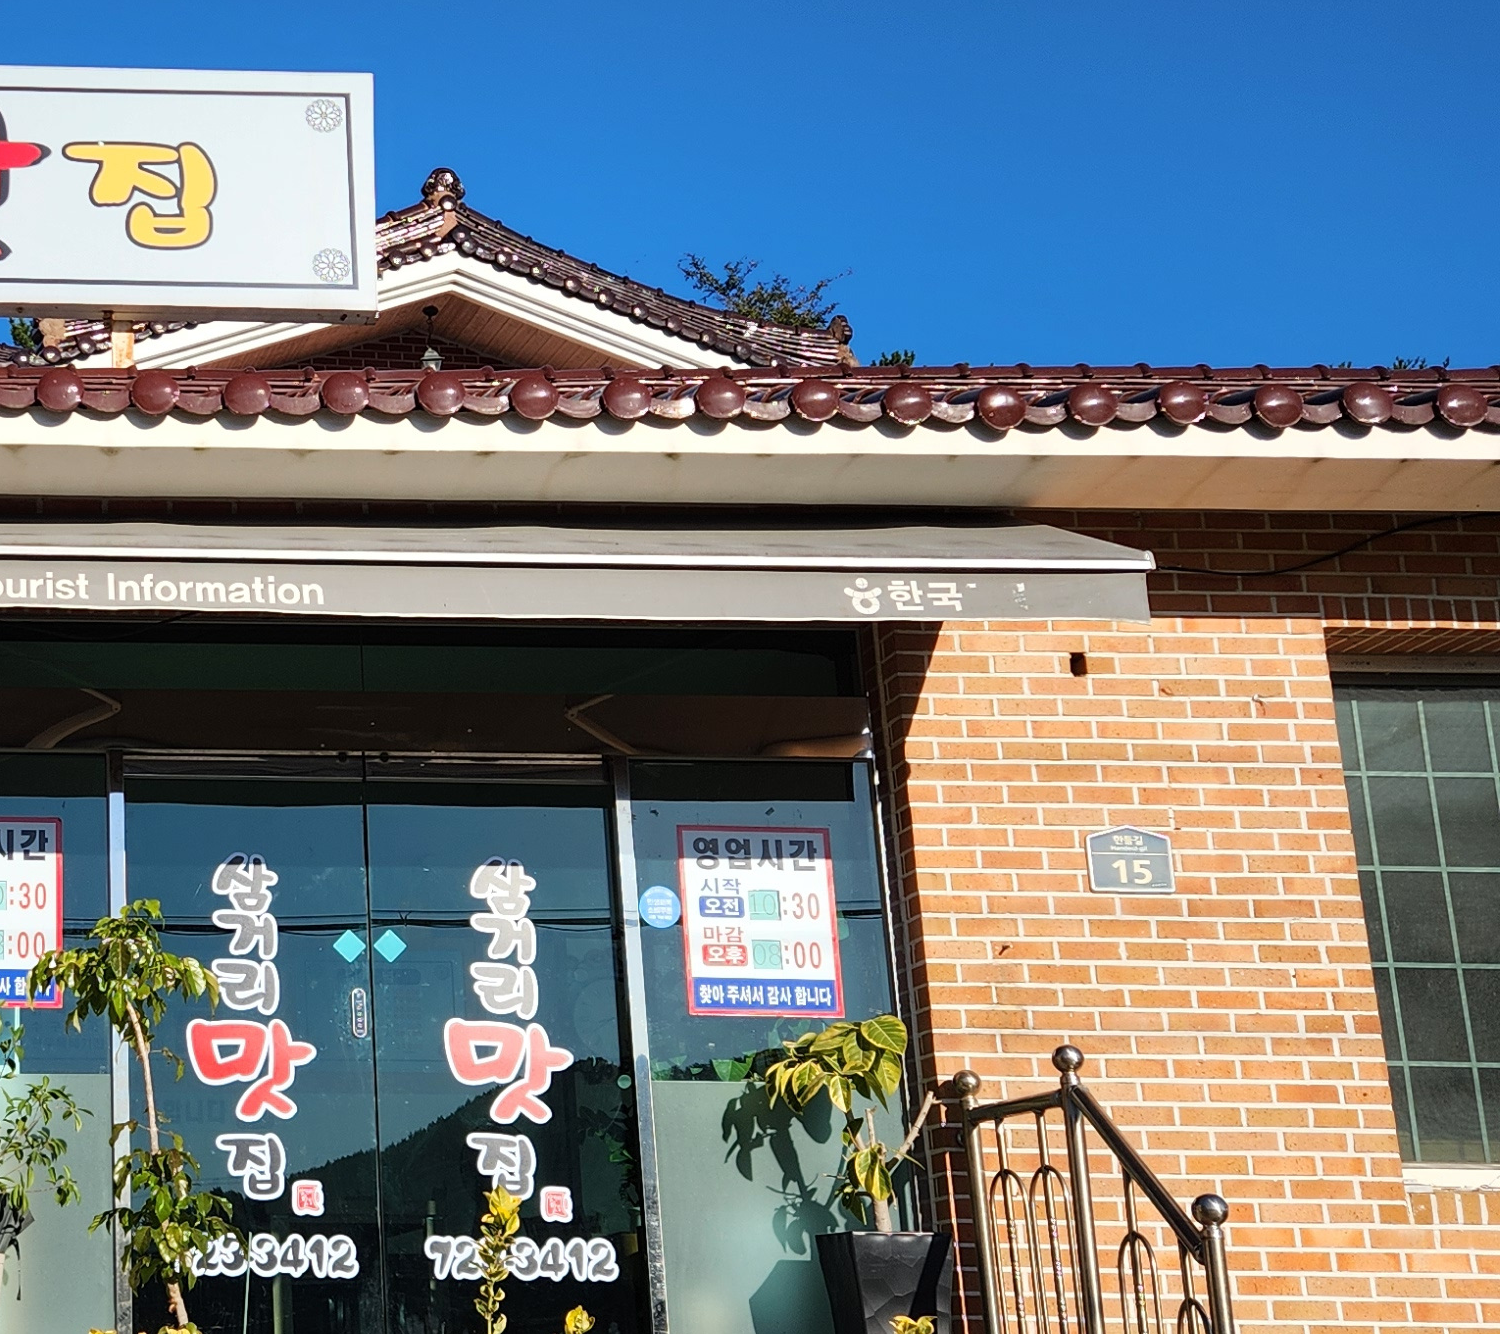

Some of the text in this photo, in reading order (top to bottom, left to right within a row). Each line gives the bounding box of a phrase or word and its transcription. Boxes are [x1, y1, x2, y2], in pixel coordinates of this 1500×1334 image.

[107, 573, 325, 605] Information
[693, 837, 817, 871] 영업시간
[1111, 859, 1153, 885] 15
[700, 878, 741, 894] 시작
[704, 898, 740, 915] 오전
[703, 926, 744, 943] 마감
[707, 946, 744, 964] 오후
[699, 984, 832, 1006] 찾아 주셔서 감사 합니다
[172, 1234, 359, 1279] 23-3412
[425, 1236, 619, 1282] 72-3412
